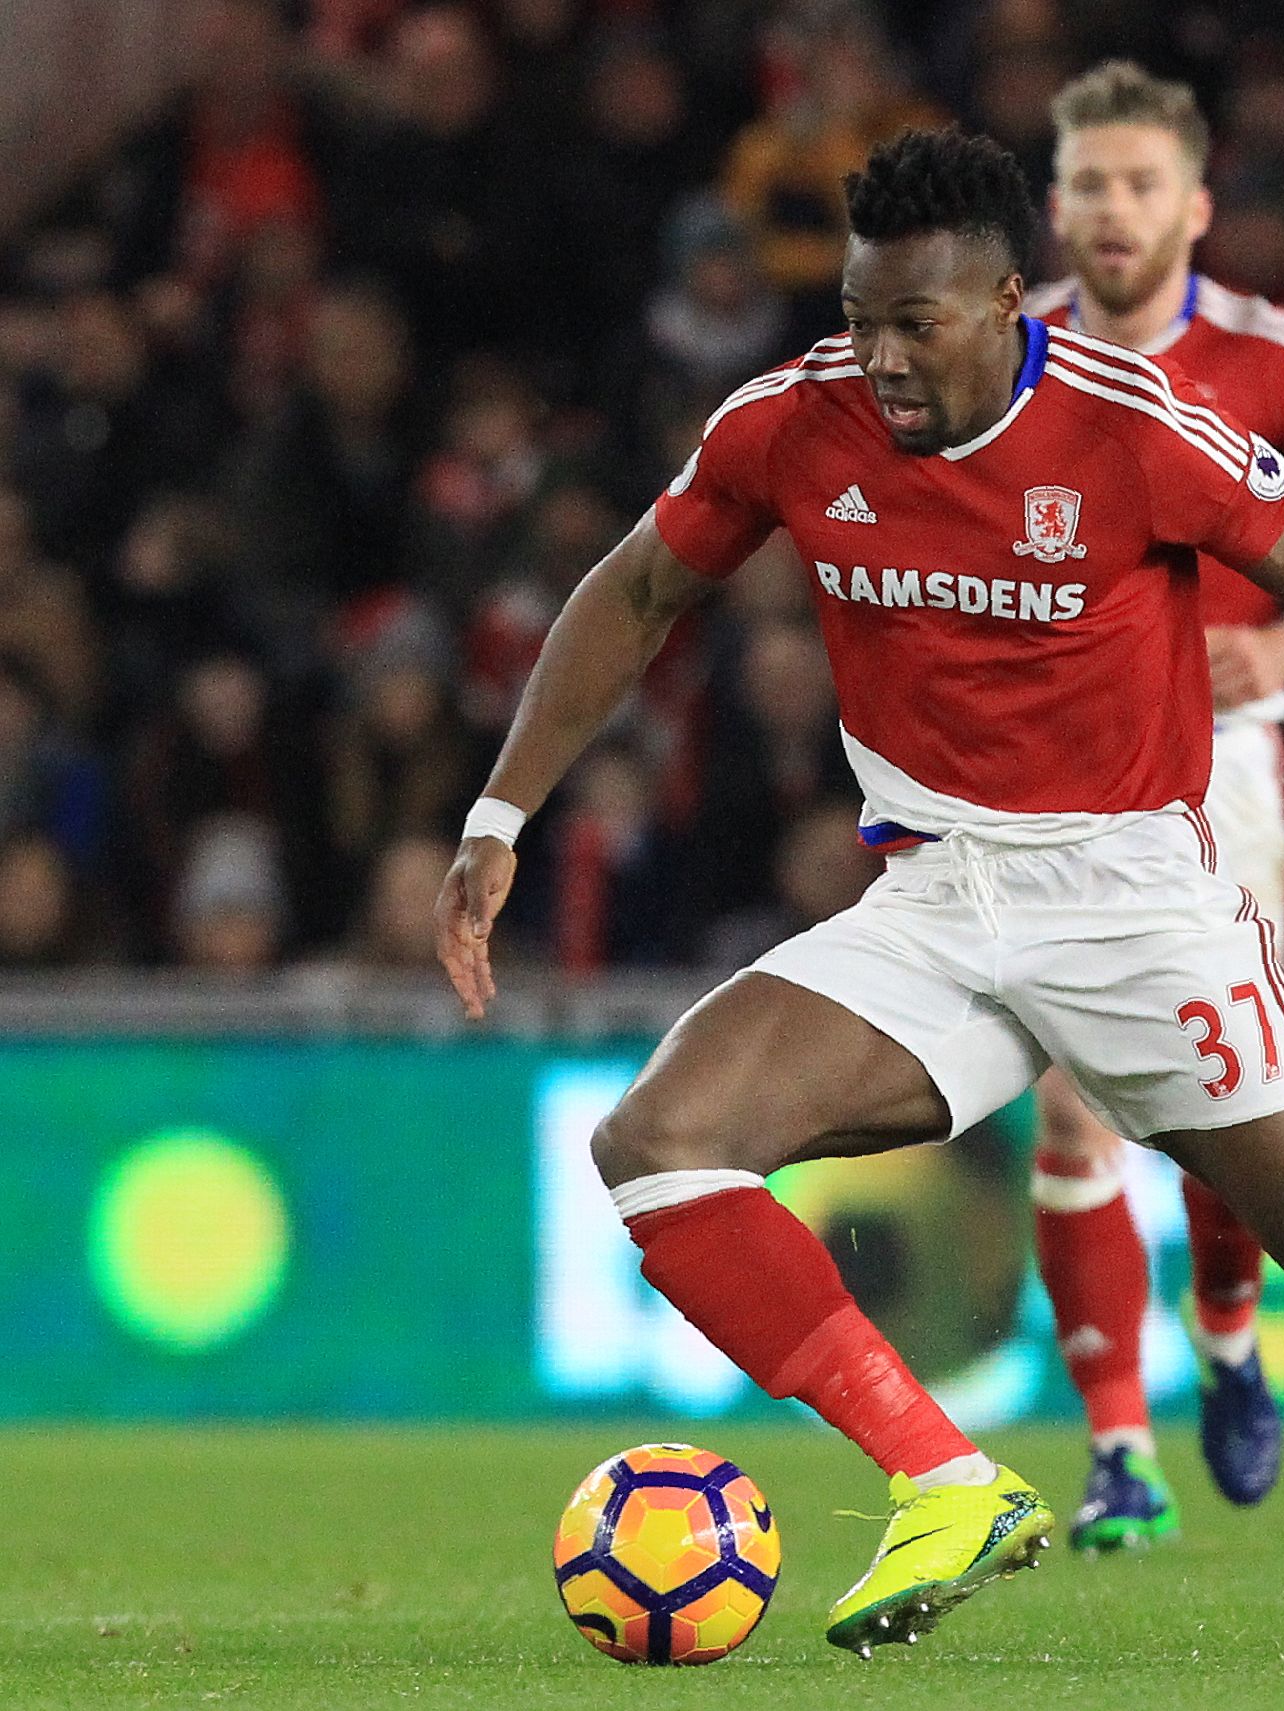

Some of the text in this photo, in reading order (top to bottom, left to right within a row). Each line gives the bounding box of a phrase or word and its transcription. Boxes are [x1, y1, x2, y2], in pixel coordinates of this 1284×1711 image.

[825, 506, 878, 524] adidas
[814, 560, 1087, 622] RAMSDENS
[1174, 979, 1281, 1100] 37
